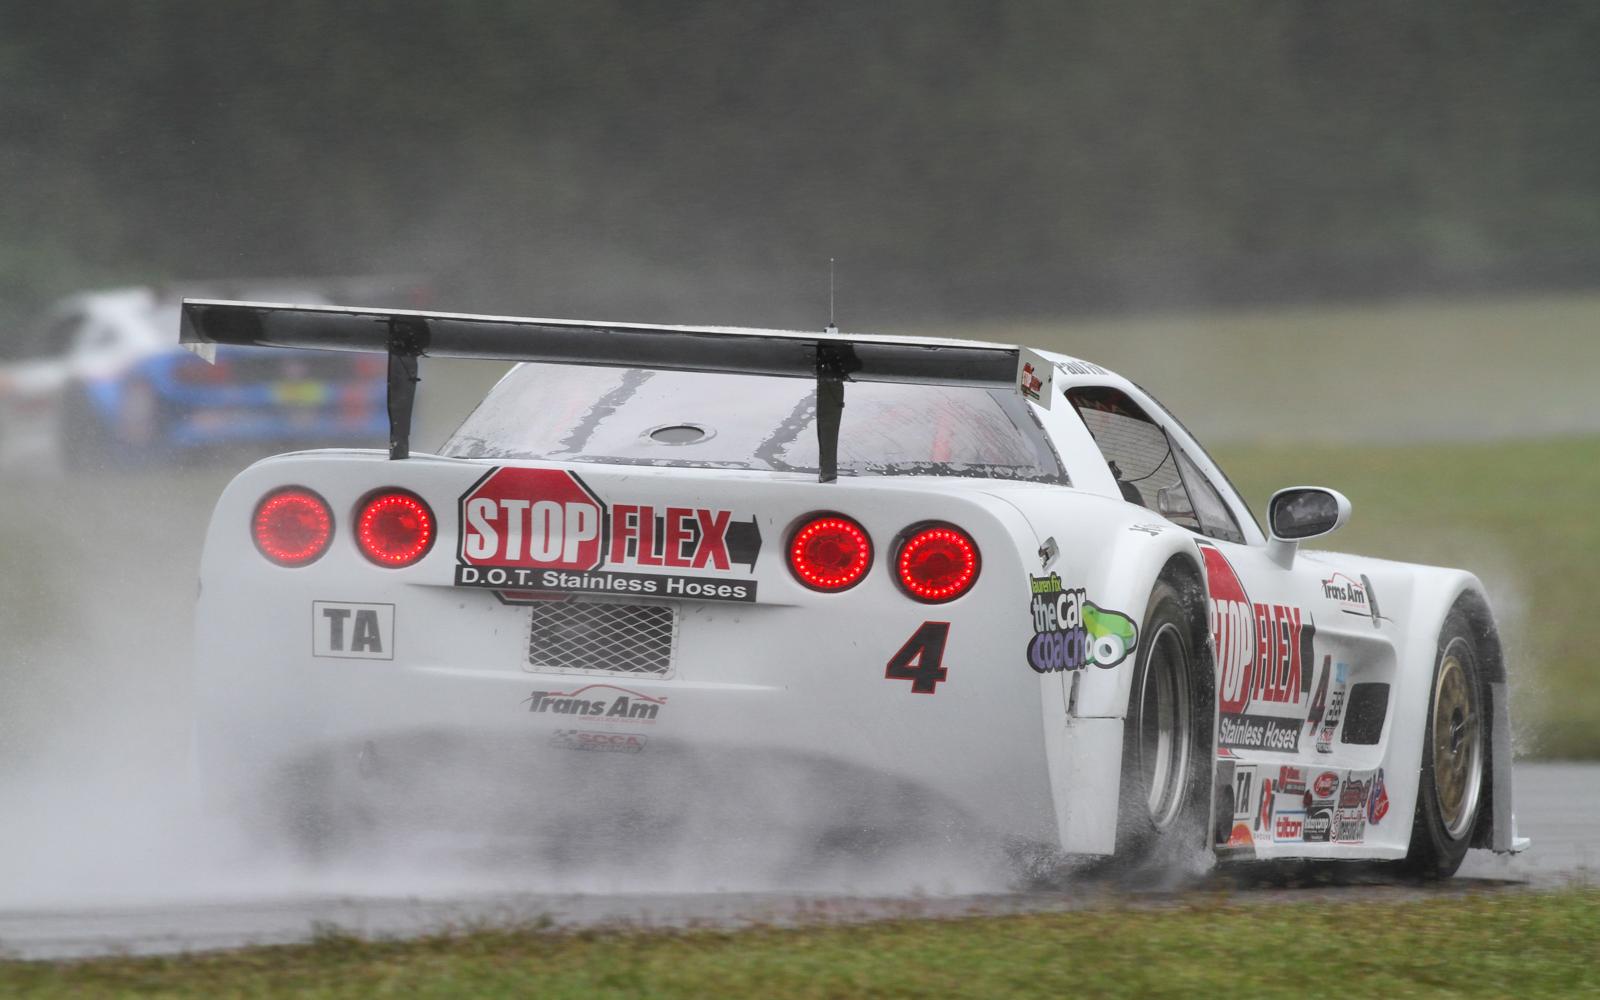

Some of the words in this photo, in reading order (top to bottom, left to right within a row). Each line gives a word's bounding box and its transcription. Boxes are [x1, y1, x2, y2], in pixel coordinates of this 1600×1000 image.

[466, 498, 599, 564] STOP
[609, 503, 733, 571] FLEX
[461, 568, 533, 586] D.O.T.
[542, 570, 657, 593] Stainless
[666, 578, 747, 599] Hoses
[1321, 579, 1346, 601] Trans
[1346, 582, 1365, 604] Am
[323, 608, 383, 653] TA
[1033, 595, 1057, 632] the
[1056, 590, 1086, 630] car
[884, 621, 951, 694] 4
[1031, 625, 1086, 670] coach
[1252, 602, 1300, 705] FLEX
[528, 690, 606, 716] Trans
[606, 695, 660, 720] Am
[1307, 655, 1331, 737] 4
[577, 733, 640, 746] SCCA
[1219, 717, 1263, 746] Stainless
[1263, 718, 1297, 748] Hoses
[1234, 771, 1252, 813] TA
